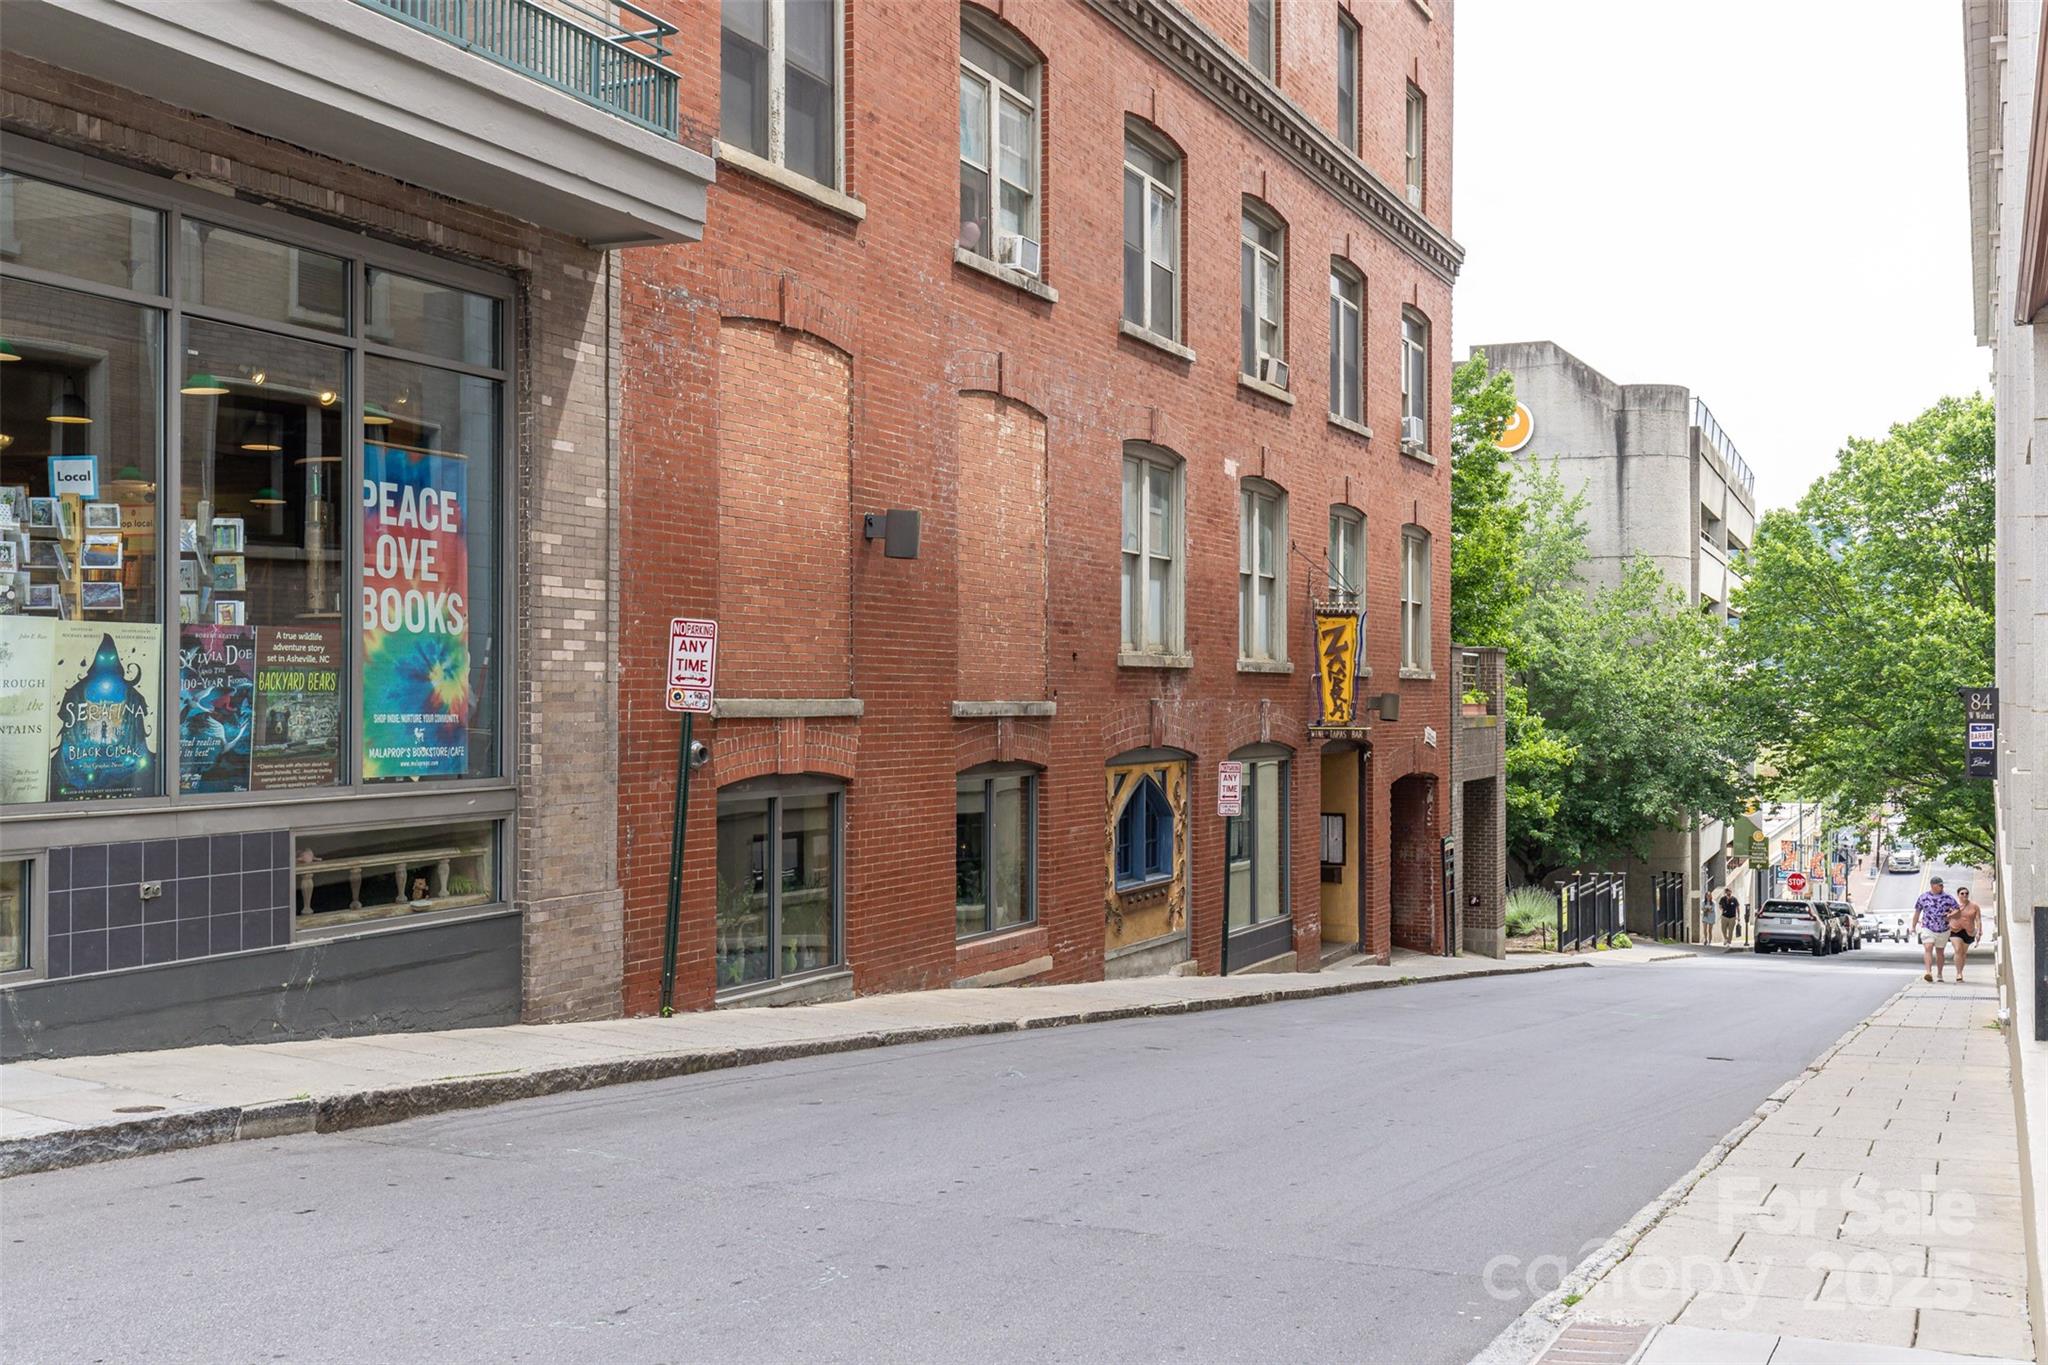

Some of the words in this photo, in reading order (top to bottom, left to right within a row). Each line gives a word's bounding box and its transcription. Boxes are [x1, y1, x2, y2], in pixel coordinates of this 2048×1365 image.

[57, 470, 91, 482] Local
[363, 479, 457, 533] PEACE
[120, 520, 133, 528] op
[134, 519, 153, 527] local
[363, 586, 464, 636] BOOKS
[673, 622, 686, 636] NO
[687, 624, 713, 637] PARKING
[276, 631, 281, 639] A
[283, 632, 296, 640] true
[298, 632, 323, 641] wildlife
[273, 643, 306, 652] adventure
[308, 644, 325, 654] story
[679, 639, 708, 653] ANY
[179, 648, 223, 669] SYLVIA
[225, 644, 253, 666] DOE
[286, 654, 318, 664] Asheville,
[319, 655, 330, 663] NC
[676, 658, 708, 673] TIME
[3, 679, 46, 688] ROUGH
[259, 671, 305, 691] BACKYARD
[307, 672, 336, 691] BEARS
[27, 698, 44, 711] the
[1971, 693, 1992, 711] 84
[65, 702, 145, 728] SERAFINA
[373, 713, 386, 723] SHOP
[423, 713, 434, 723] YOUR
[1975, 712, 1995, 720] Walnut
[1330, 729, 1347, 739] TAPAS
[1351, 730, 1363, 739] BAR
[1970, 732, 1993, 740] BARBER
[68, 745, 101, 760] BLACK
[105, 745, 142, 758] CLOAK
[368, 747, 411, 758] MALAPROP'S
[1223, 774, 1238, 782] ANY
[1222, 785, 1238, 793] TIME
[1788, 878, 1804, 886] STOP
